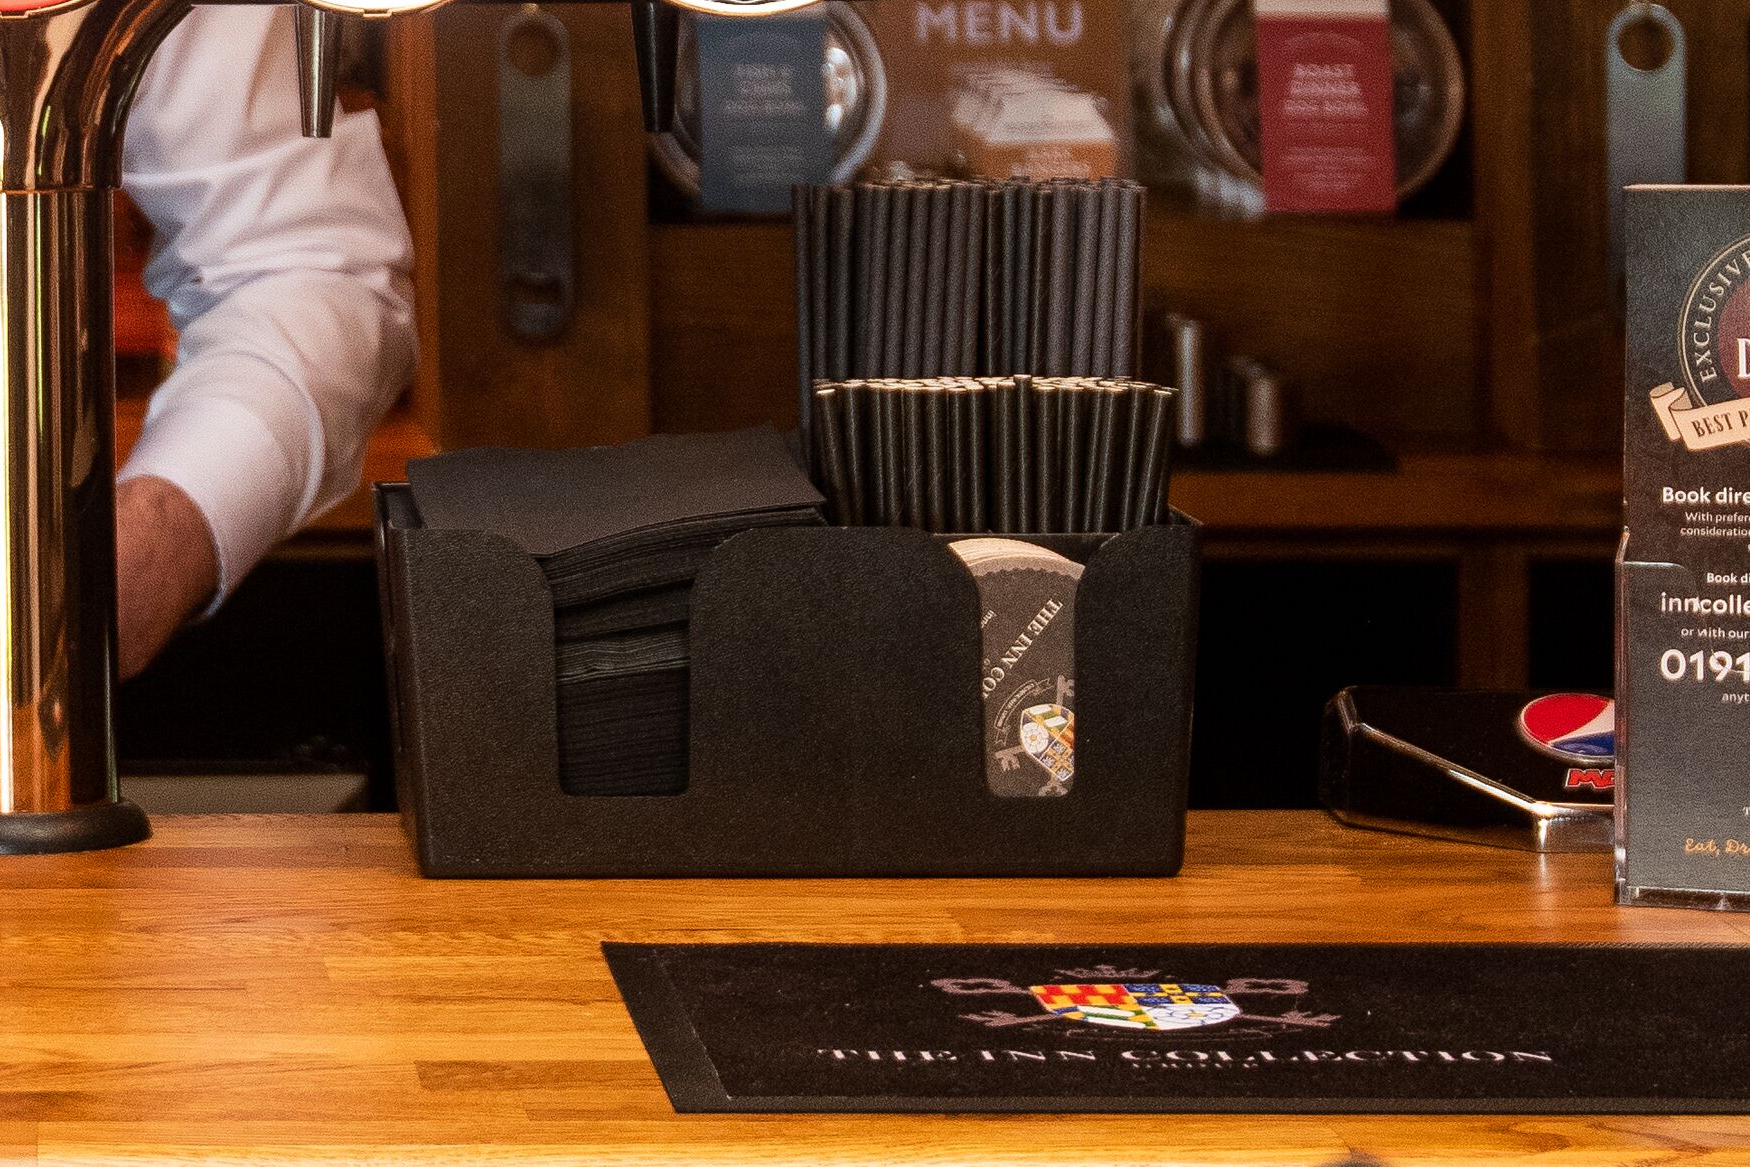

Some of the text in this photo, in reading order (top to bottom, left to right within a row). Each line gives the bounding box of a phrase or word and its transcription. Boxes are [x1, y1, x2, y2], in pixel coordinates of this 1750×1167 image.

[915, 0, 1084, 47] MENU
[1691, 412, 1734, 437] BEST
[1662, 486, 1711, 504] Book
[1685, 512, 1713, 522] With
[1707, 572, 1737, 583] Book
[1027, 598, 1063, 635] THE
[1681, 628, 1694, 637] or
[1001, 633, 1033, 669] INN
[1661, 648, 1750, 682] 0191
[817, 1048, 1552, 1063] THE INN COLLECTION
